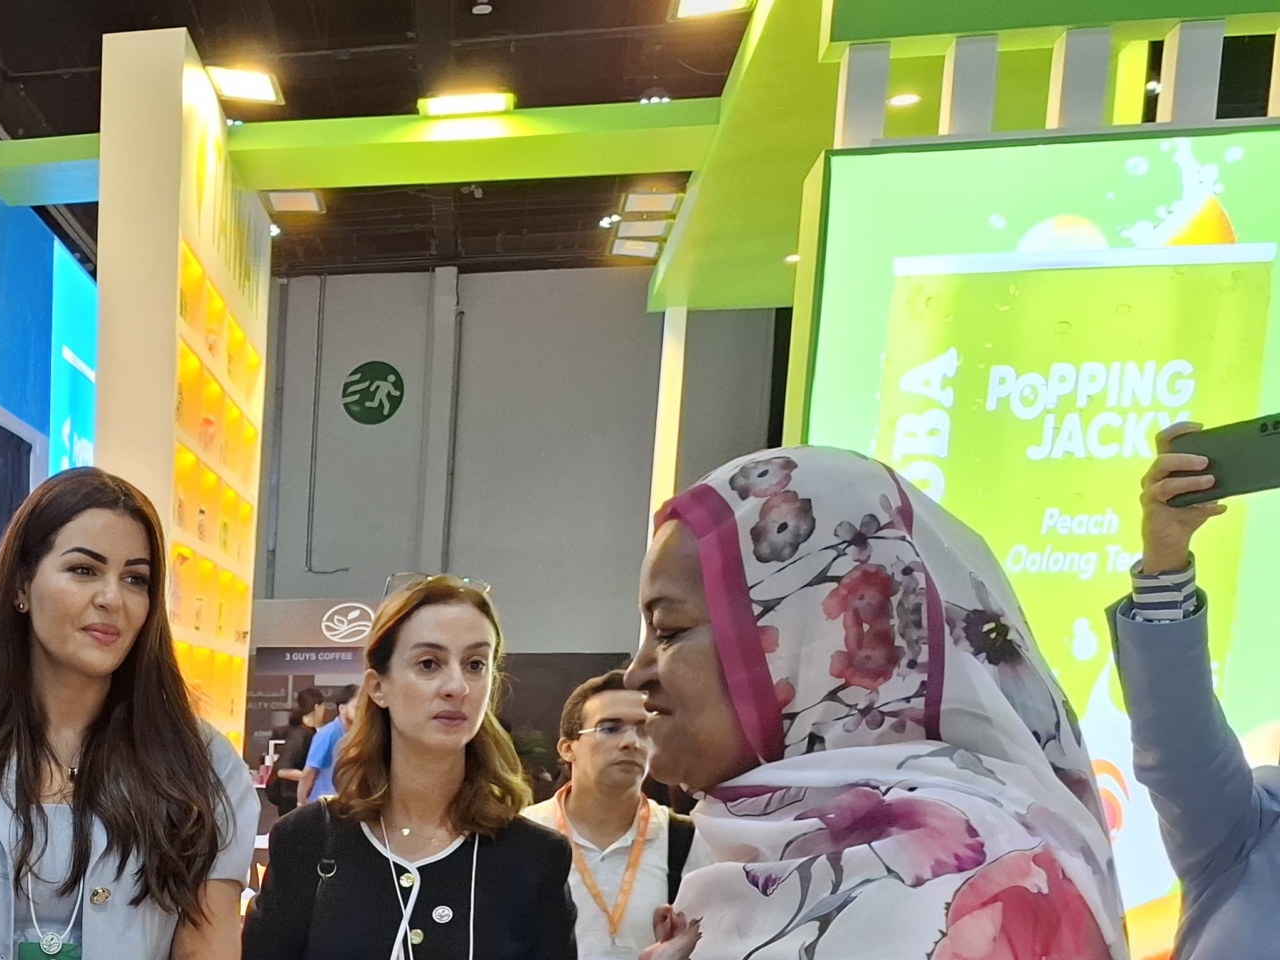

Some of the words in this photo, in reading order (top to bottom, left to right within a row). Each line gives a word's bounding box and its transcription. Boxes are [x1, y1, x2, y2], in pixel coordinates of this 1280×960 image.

[985, 359, 1196, 421] POPPING
[892, 346, 958, 503] OBA
[1040, 507, 1119, 536] Peach
[1006, 543, 1099, 580] Oolong
[285, 653, 291, 661] 3
[292, 652, 316, 661] GUYS
[318, 652, 353, 661] COFFEE
